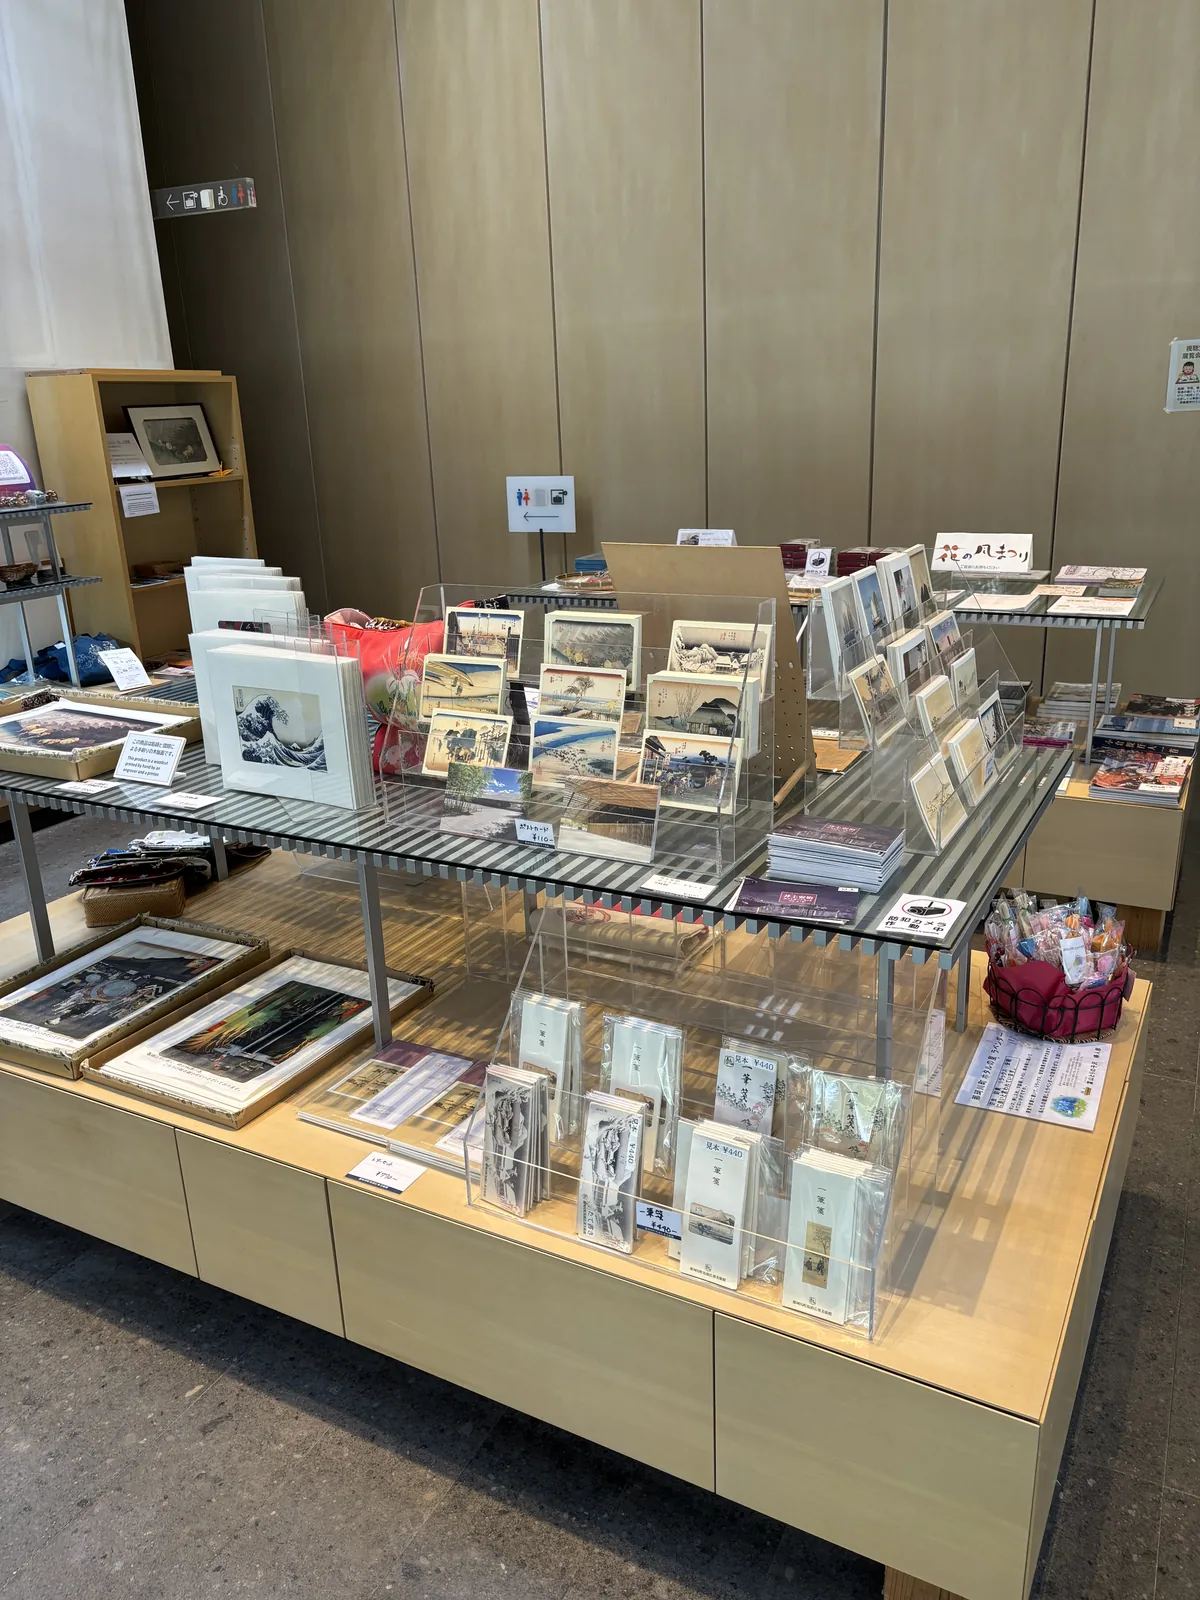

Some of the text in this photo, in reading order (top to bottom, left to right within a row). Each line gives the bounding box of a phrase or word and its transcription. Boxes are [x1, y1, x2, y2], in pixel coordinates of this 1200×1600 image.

[936, 544, 1028, 563] 花の風まつり
[520, 823, 549, 832] ポストカード
[888, 915, 947, 927] 防犯カメラ
[735, 1055, 774, 1071] 見本 ¥440
[627, 1118, 639, 1164] 見本 ¥440
[706, 1141, 743, 1158] 見本 ¥440
